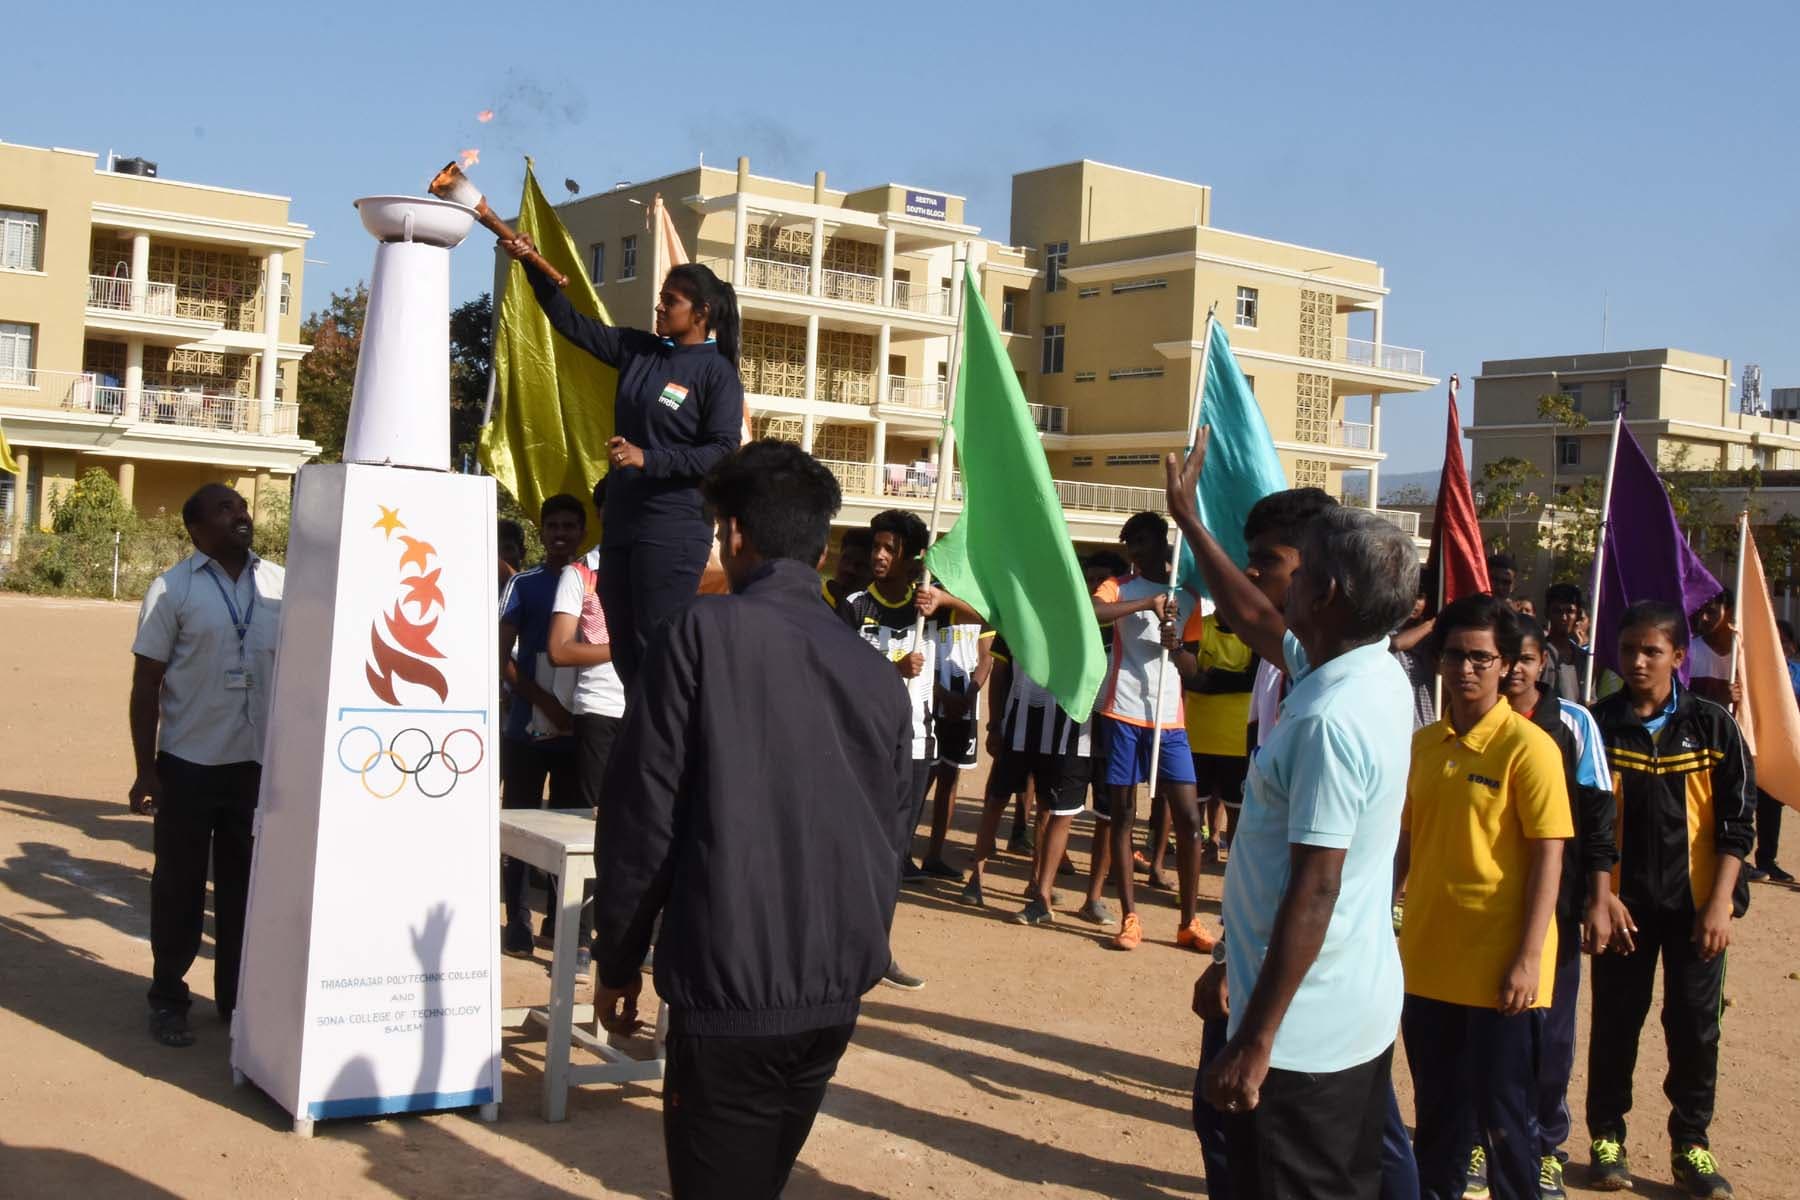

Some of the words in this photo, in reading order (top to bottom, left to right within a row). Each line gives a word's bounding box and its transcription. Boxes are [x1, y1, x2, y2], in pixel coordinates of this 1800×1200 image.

[906, 205, 926, 216] SOUTH
[926, 208, 945, 218] BLOCK
[320, 977, 383, 989] THIAGARAJAR
[386, 973, 445, 985] POLYTECHNIC
[447, 970, 489, 981] COLLEGE
[390, 993, 416, 1001] AND
[317, 1015, 345, 1026] SONA
[349, 1012, 391, 1024] COLLEGE
[394, 1011, 407, 1021] OF
[412, 1006, 480, 1018] TECHNOLOGY
[384, 1023, 424, 1034] SALEM
